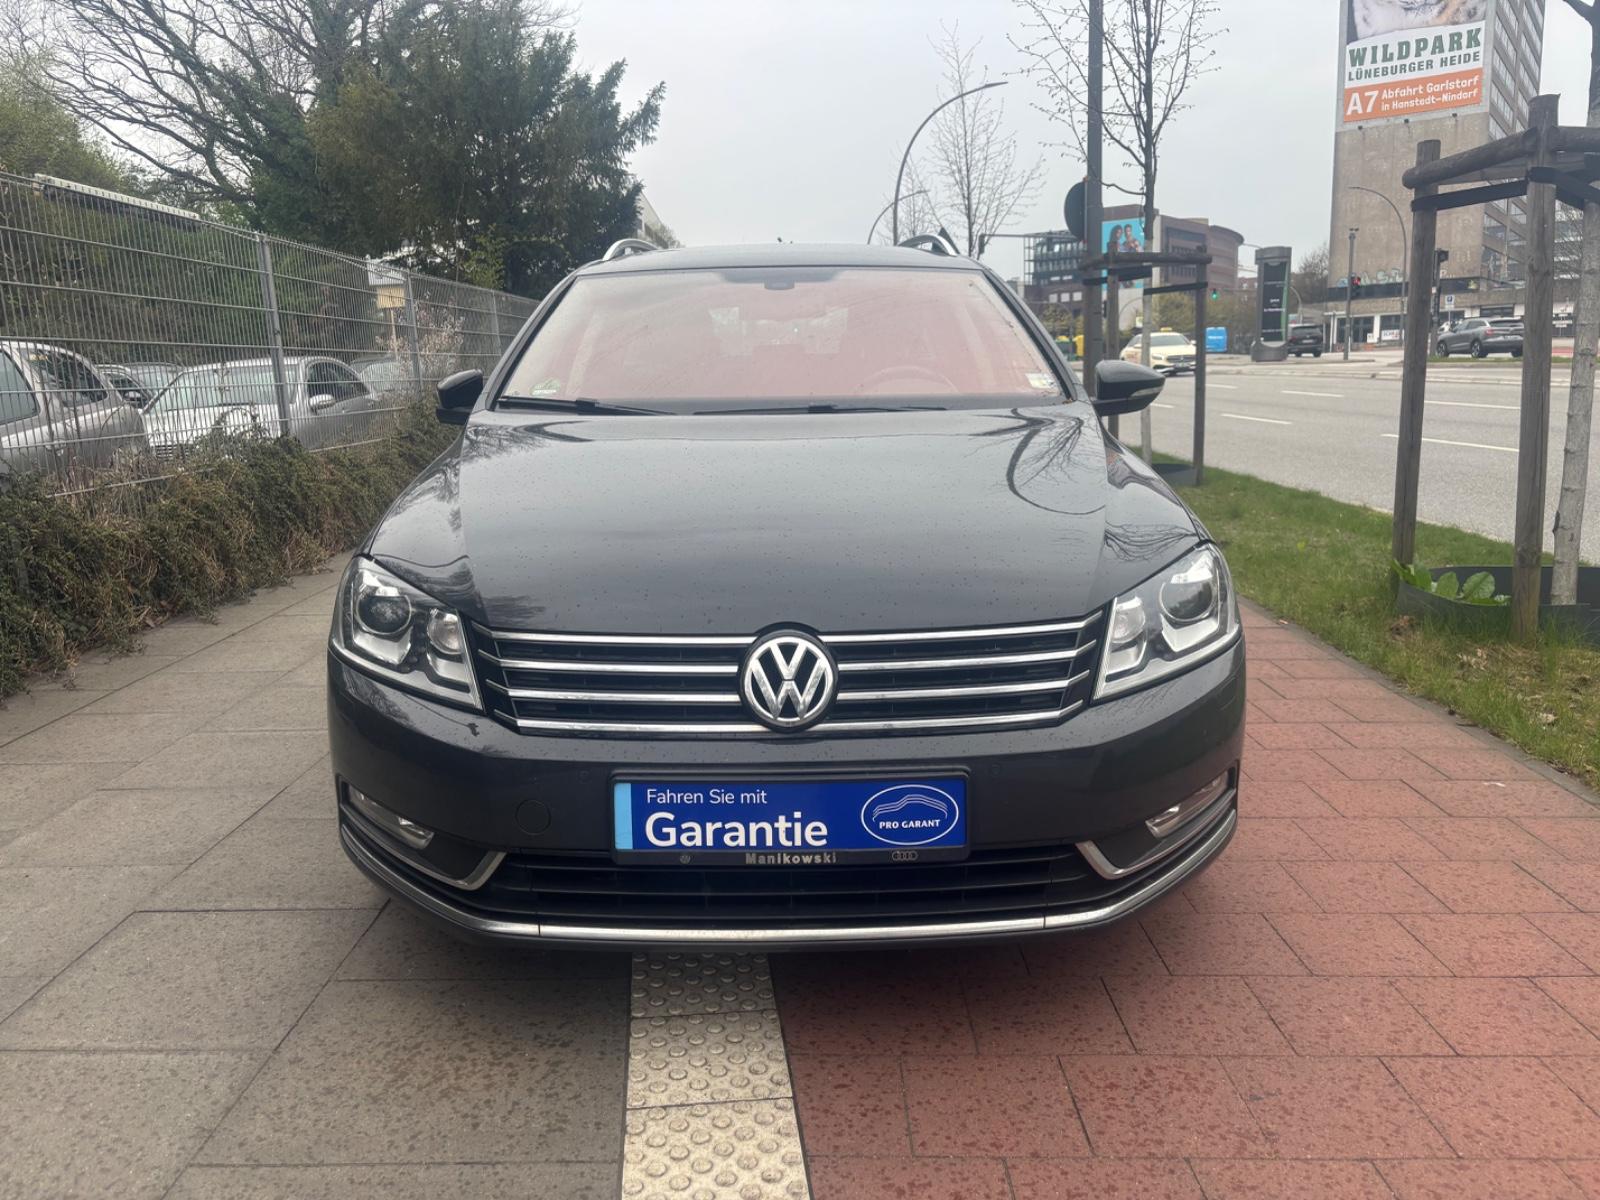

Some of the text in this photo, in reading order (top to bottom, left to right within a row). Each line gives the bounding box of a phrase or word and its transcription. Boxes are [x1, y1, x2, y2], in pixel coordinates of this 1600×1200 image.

[1349, 28, 1481, 67] WILDPARK
[1348, 51, 1480, 81] LÜNEBURGER HEIDE
[1382, 84, 1424, 100] Abfahrt
[1346, 90, 1379, 115] A7
[1382, 102, 1390, 111] in
[646, 788, 768, 804] Fahren Sie mit
[645, 811, 828, 847] Garantie
[879, 819, 941, 829] PRO GARANT
[745, 852, 837, 865] Manikowski
